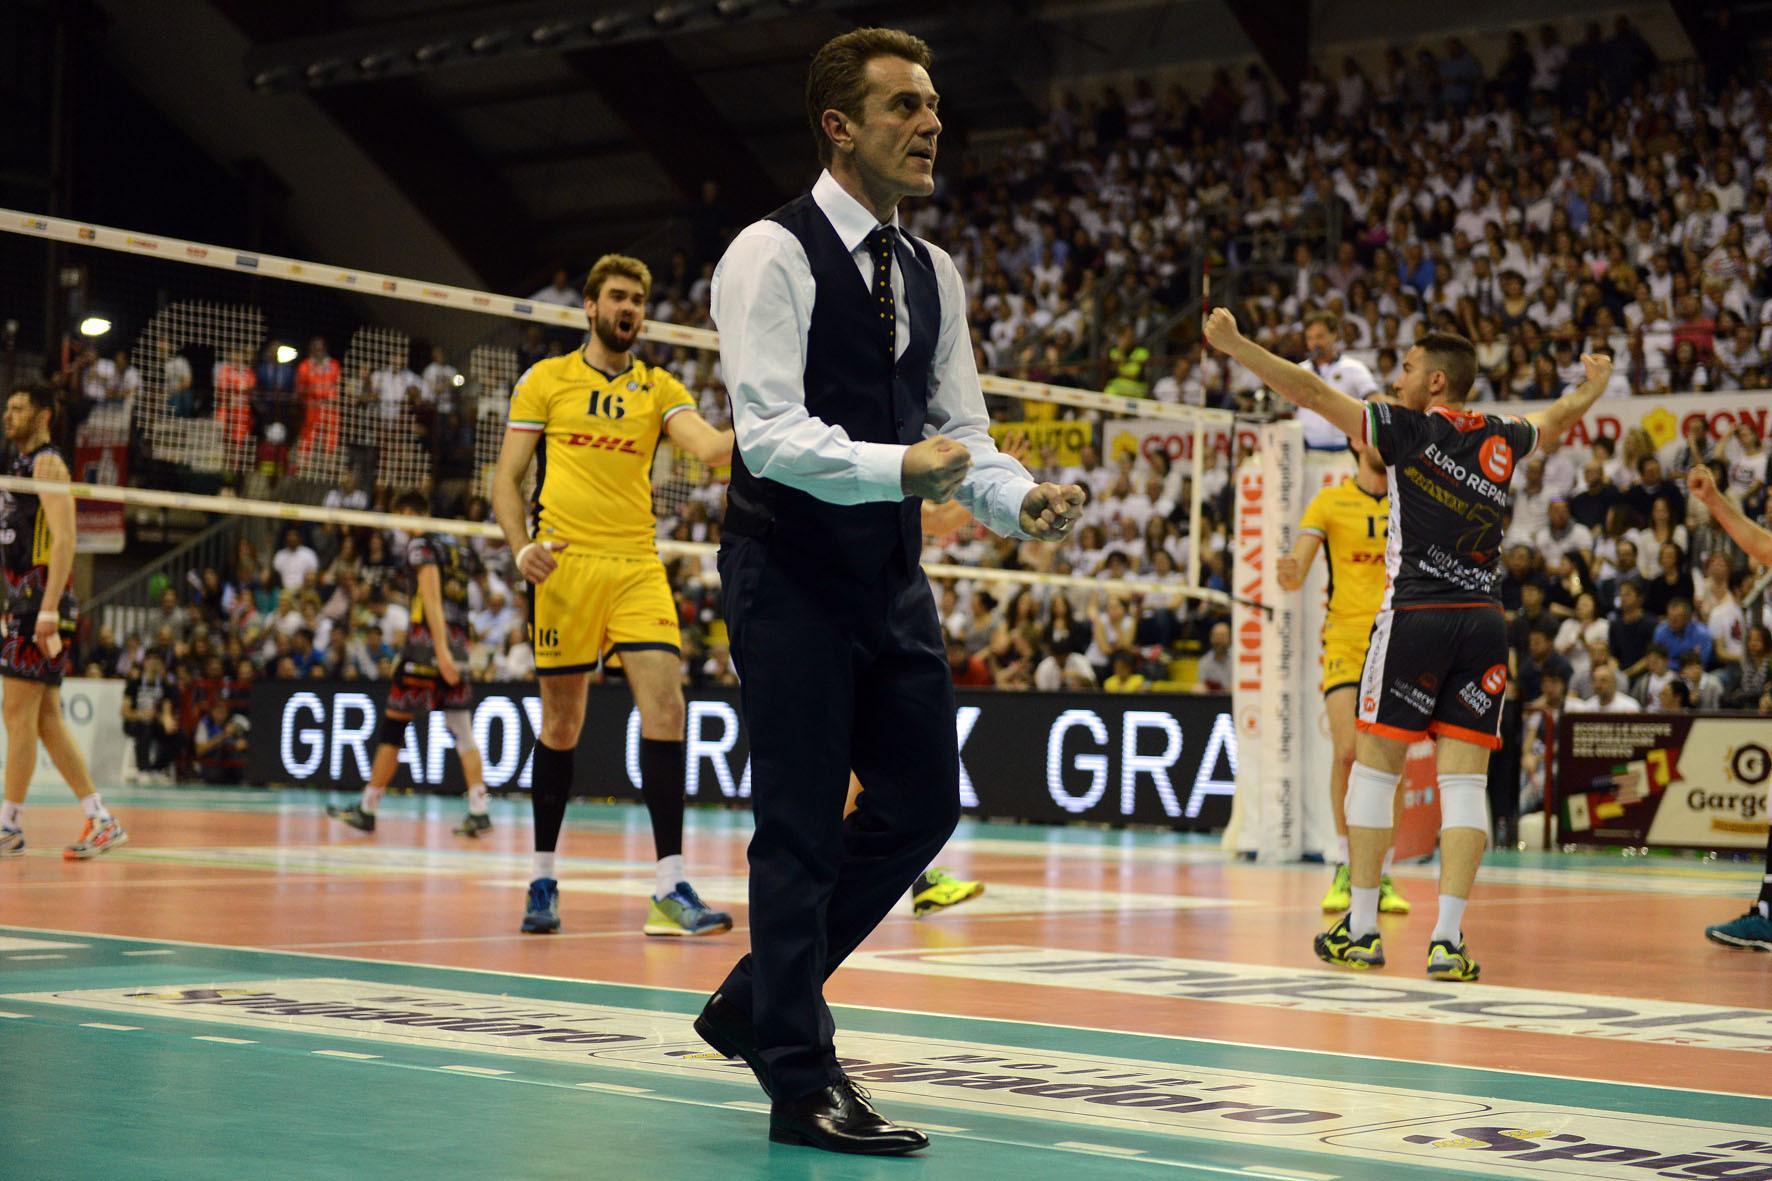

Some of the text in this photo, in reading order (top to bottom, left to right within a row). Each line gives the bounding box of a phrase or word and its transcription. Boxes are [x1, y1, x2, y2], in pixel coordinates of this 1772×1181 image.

[586, 390, 625, 420] 16
[564, 432, 642, 455] DHL
[1424, 443, 1466, 481] EURO
[1238, 474, 1263, 691] LIOMATIC
[539, 628, 559, 648] 16
[1465, 681, 1492, 710] EURO
[124, 988, 647, 1044] Spigadoro
[663, 1050, 1343, 1125] igadoro
